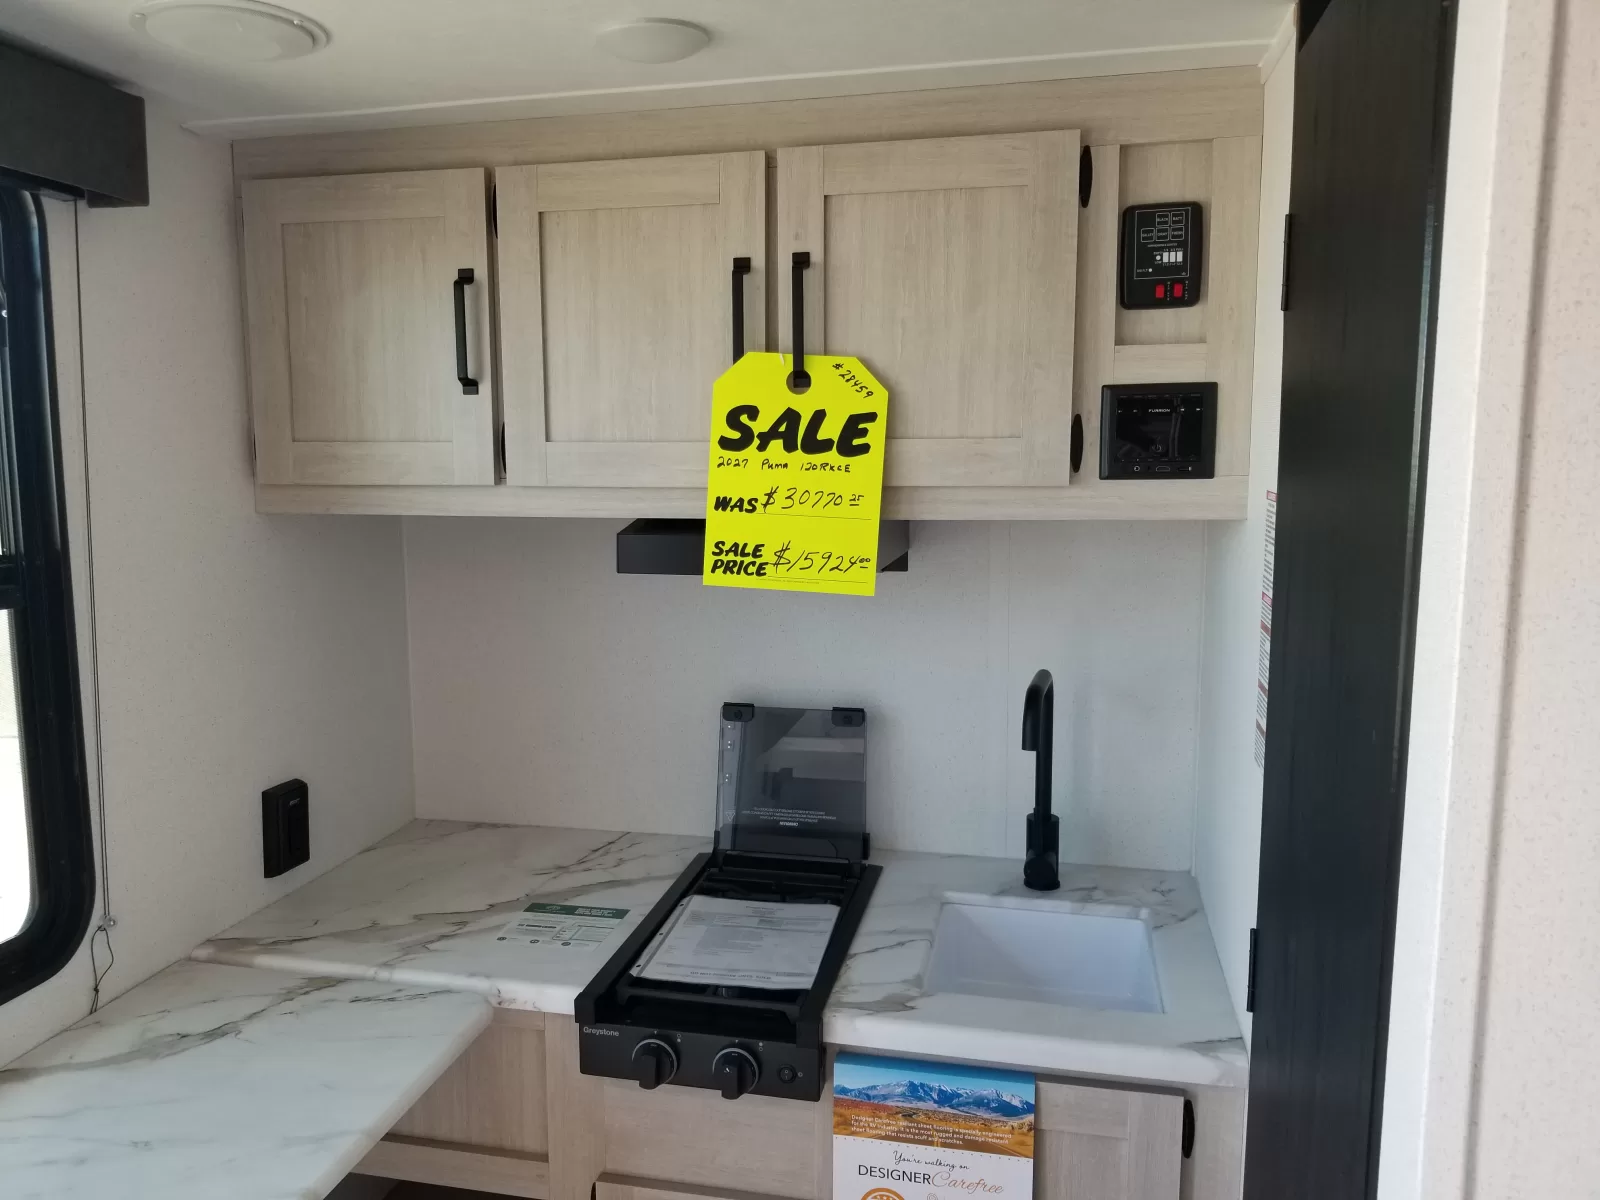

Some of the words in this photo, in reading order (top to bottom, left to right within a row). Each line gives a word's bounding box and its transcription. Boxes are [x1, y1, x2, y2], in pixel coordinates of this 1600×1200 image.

[832, 363, 874, 399] #28459
[717, 404, 879, 458] SALE
[716, 456, 749, 469] 2027
[713, 496, 759, 514] WAS
[711, 540, 766, 559] SALE
[710, 559, 769, 577] PRICE
[583, 1026, 620, 1037] Greystone
[866, 1128, 886, 1136] flooring
[874, 1117, 896, 1125] Carefree
[982, 1131, 1012, 1139] engineered
[892, 1150, 923, 1166] You're
[924, 1158, 957, 1172] walking
[858, 1164, 932, 1185] DESIGNER
[931, 1171, 1004, 1195] Carefree
